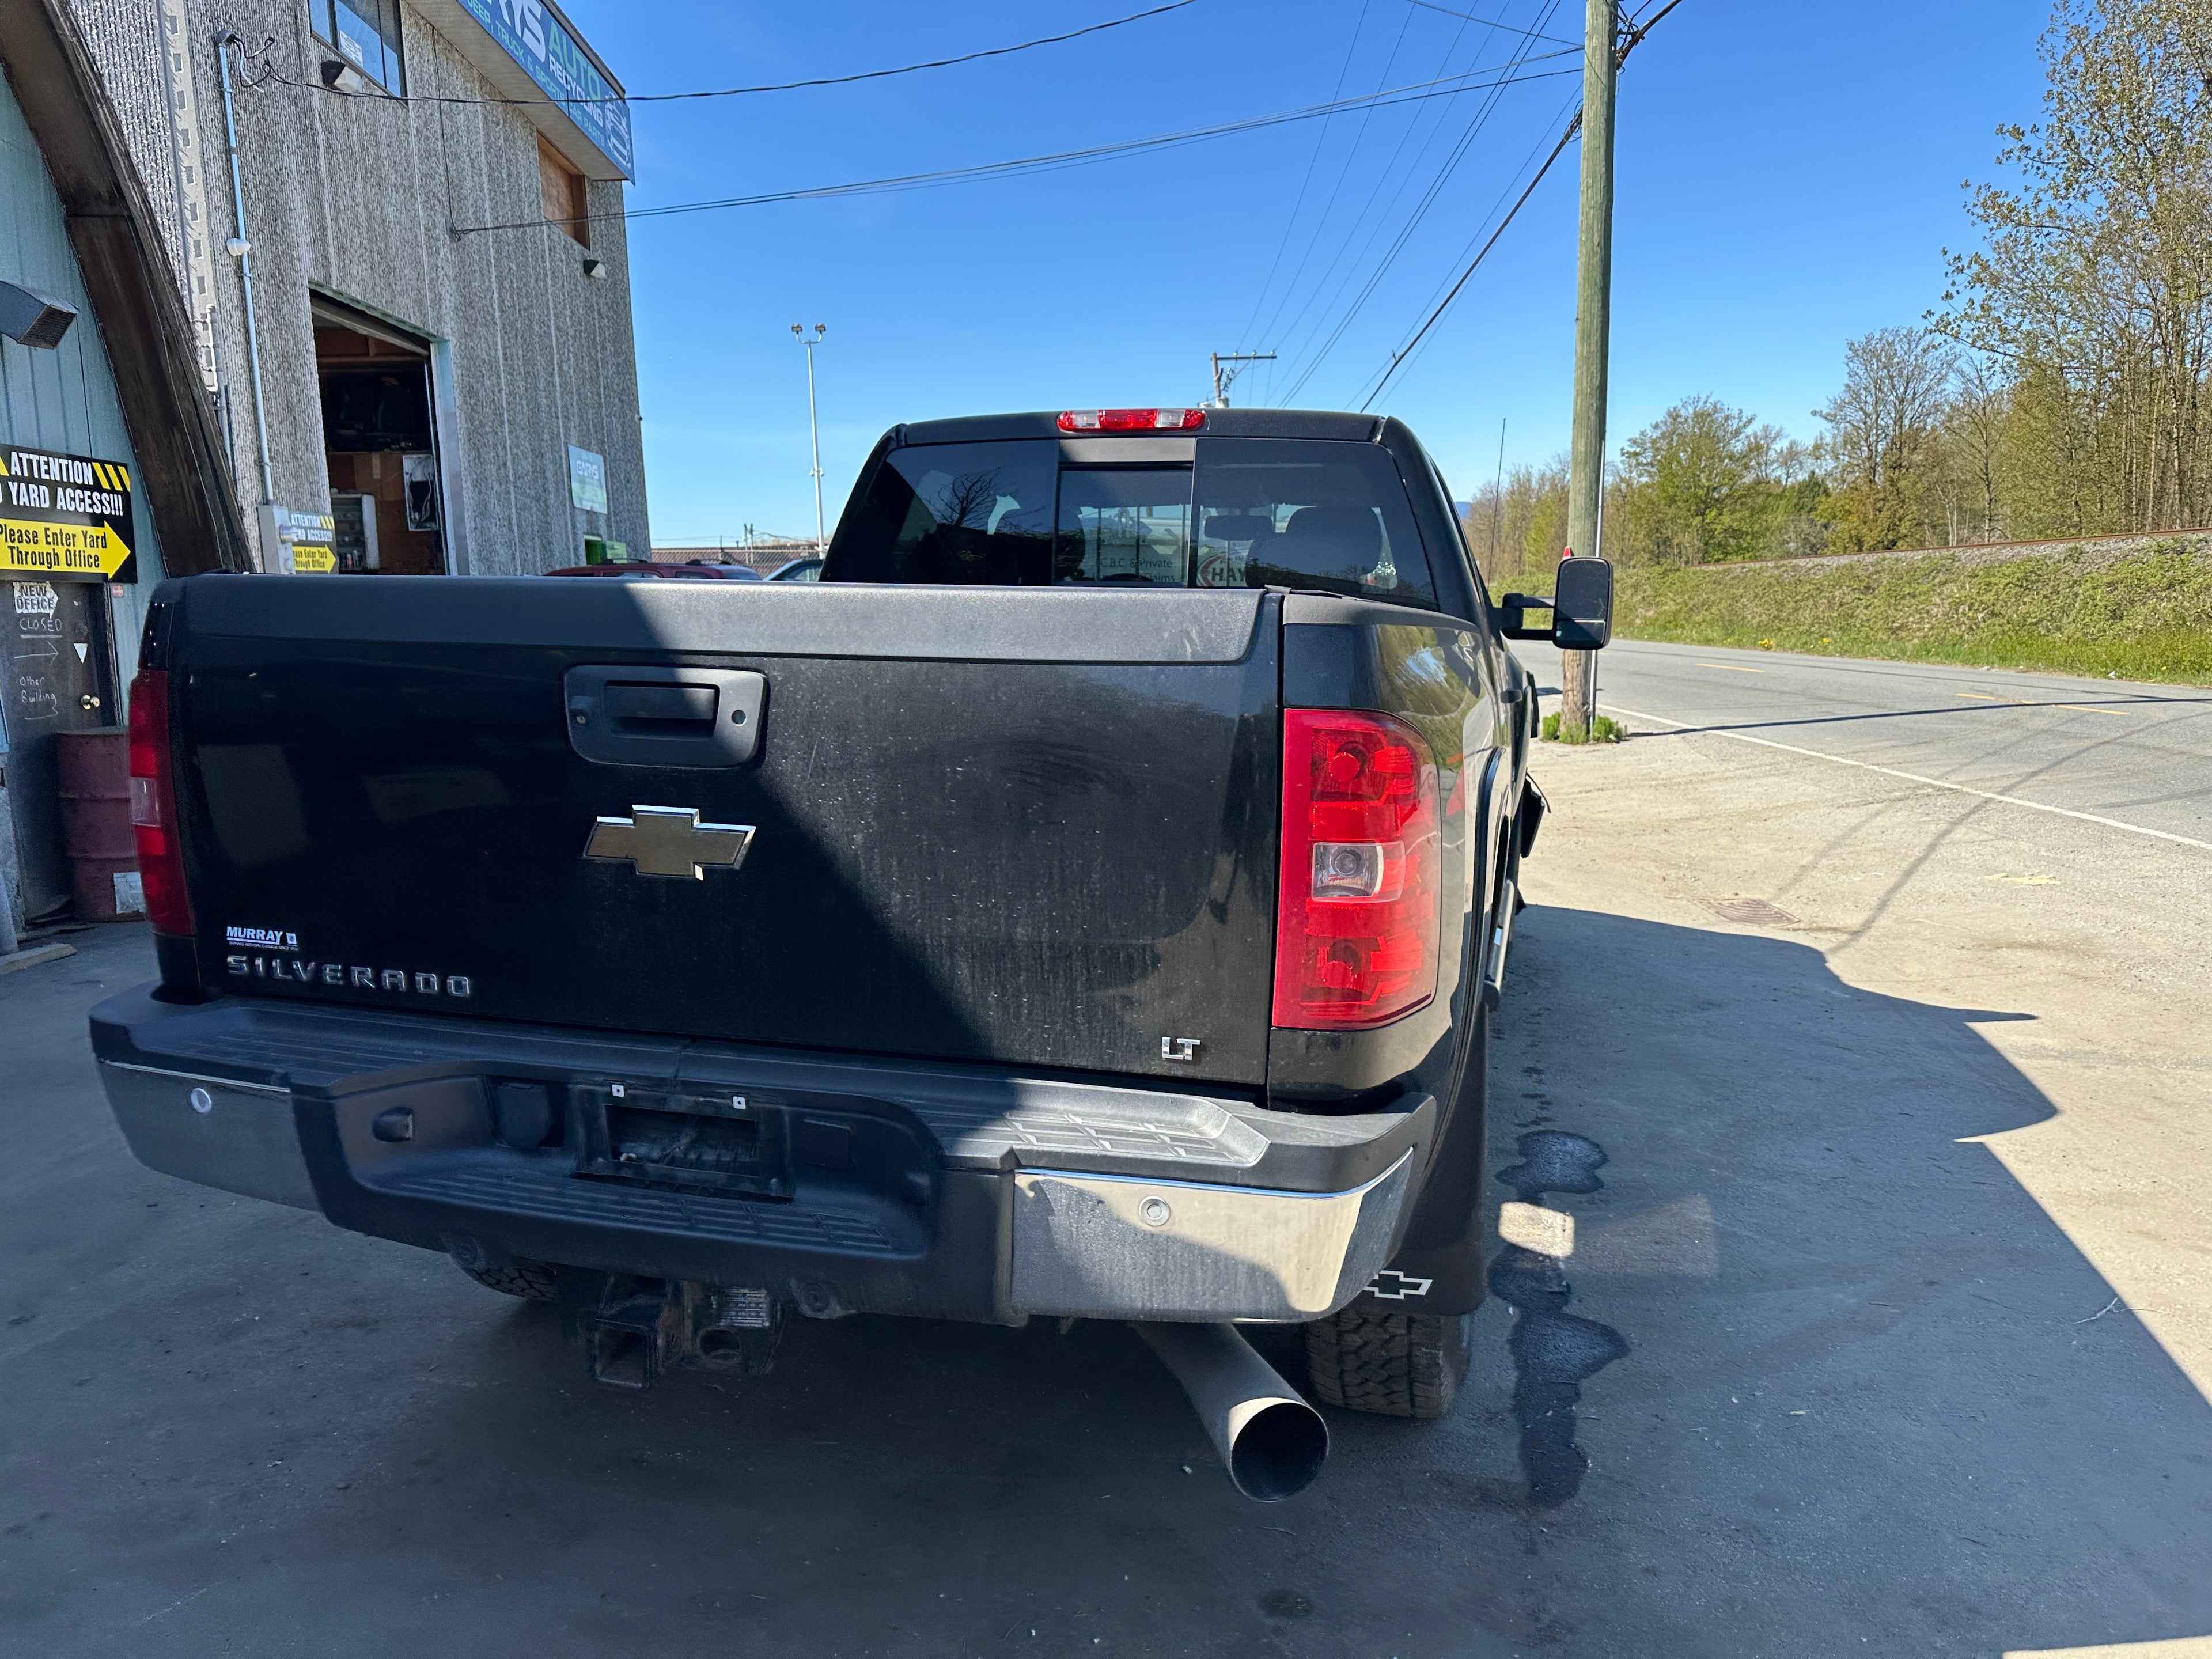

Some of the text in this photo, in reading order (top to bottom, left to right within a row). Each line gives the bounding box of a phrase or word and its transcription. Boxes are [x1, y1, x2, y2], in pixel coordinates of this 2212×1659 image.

[549, 21, 601, 105] AUTO
[495, 21, 525, 63] TRUCK
[569, 102, 582, 122] CAR
[584, 119, 605, 146] PARTS
[549, 52, 603, 127] RECYCLING
[11, 451, 93, 485] ATTENTION
[8, 481, 50, 509] YARD
[56, 487, 123, 516] ACCESS!!!
[0, 524, 107, 549] Please Enter Yard
[7, 546, 100, 569] Through Office
[1140, 558, 1173, 568] Private
[20, 584, 47, 597] NEW
[16, 596, 55, 610] OFFICE
[20, 618, 62, 631] CLOSED
[19, 676, 45, 686] Other
[21, 690, 57, 707] Building
[226, 926, 283, 945] MURRAY
[226, 955, 471, 997] SILVERADO
[1162, 1037, 1200, 1060] LT
